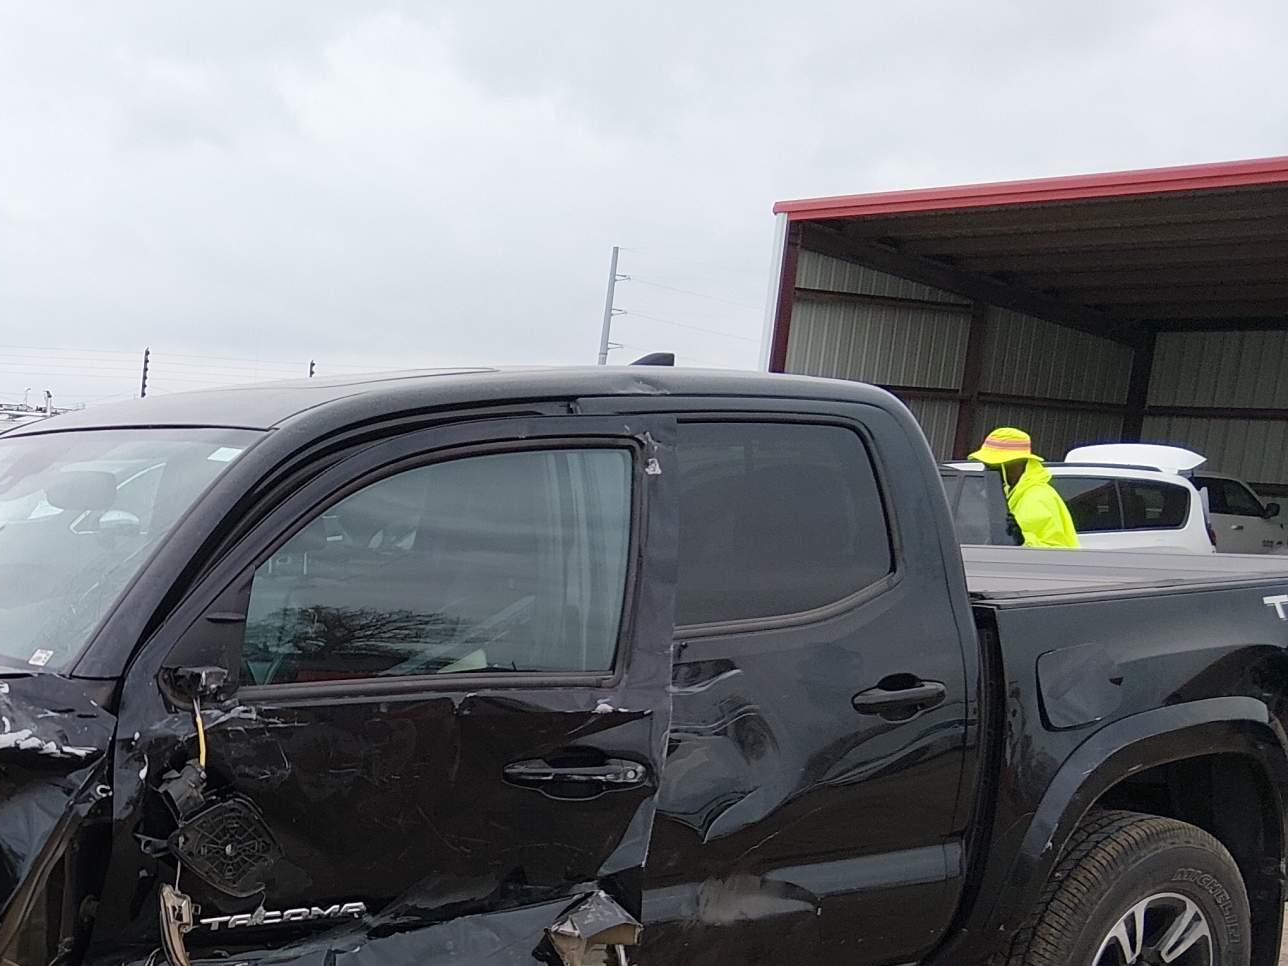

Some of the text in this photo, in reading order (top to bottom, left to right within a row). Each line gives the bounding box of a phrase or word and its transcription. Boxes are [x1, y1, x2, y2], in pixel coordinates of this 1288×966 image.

[1263, 594, 1288, 619] T
[199, 901, 367, 931] TACOMA
[1171, 867, 1241, 944] MICHELIN
